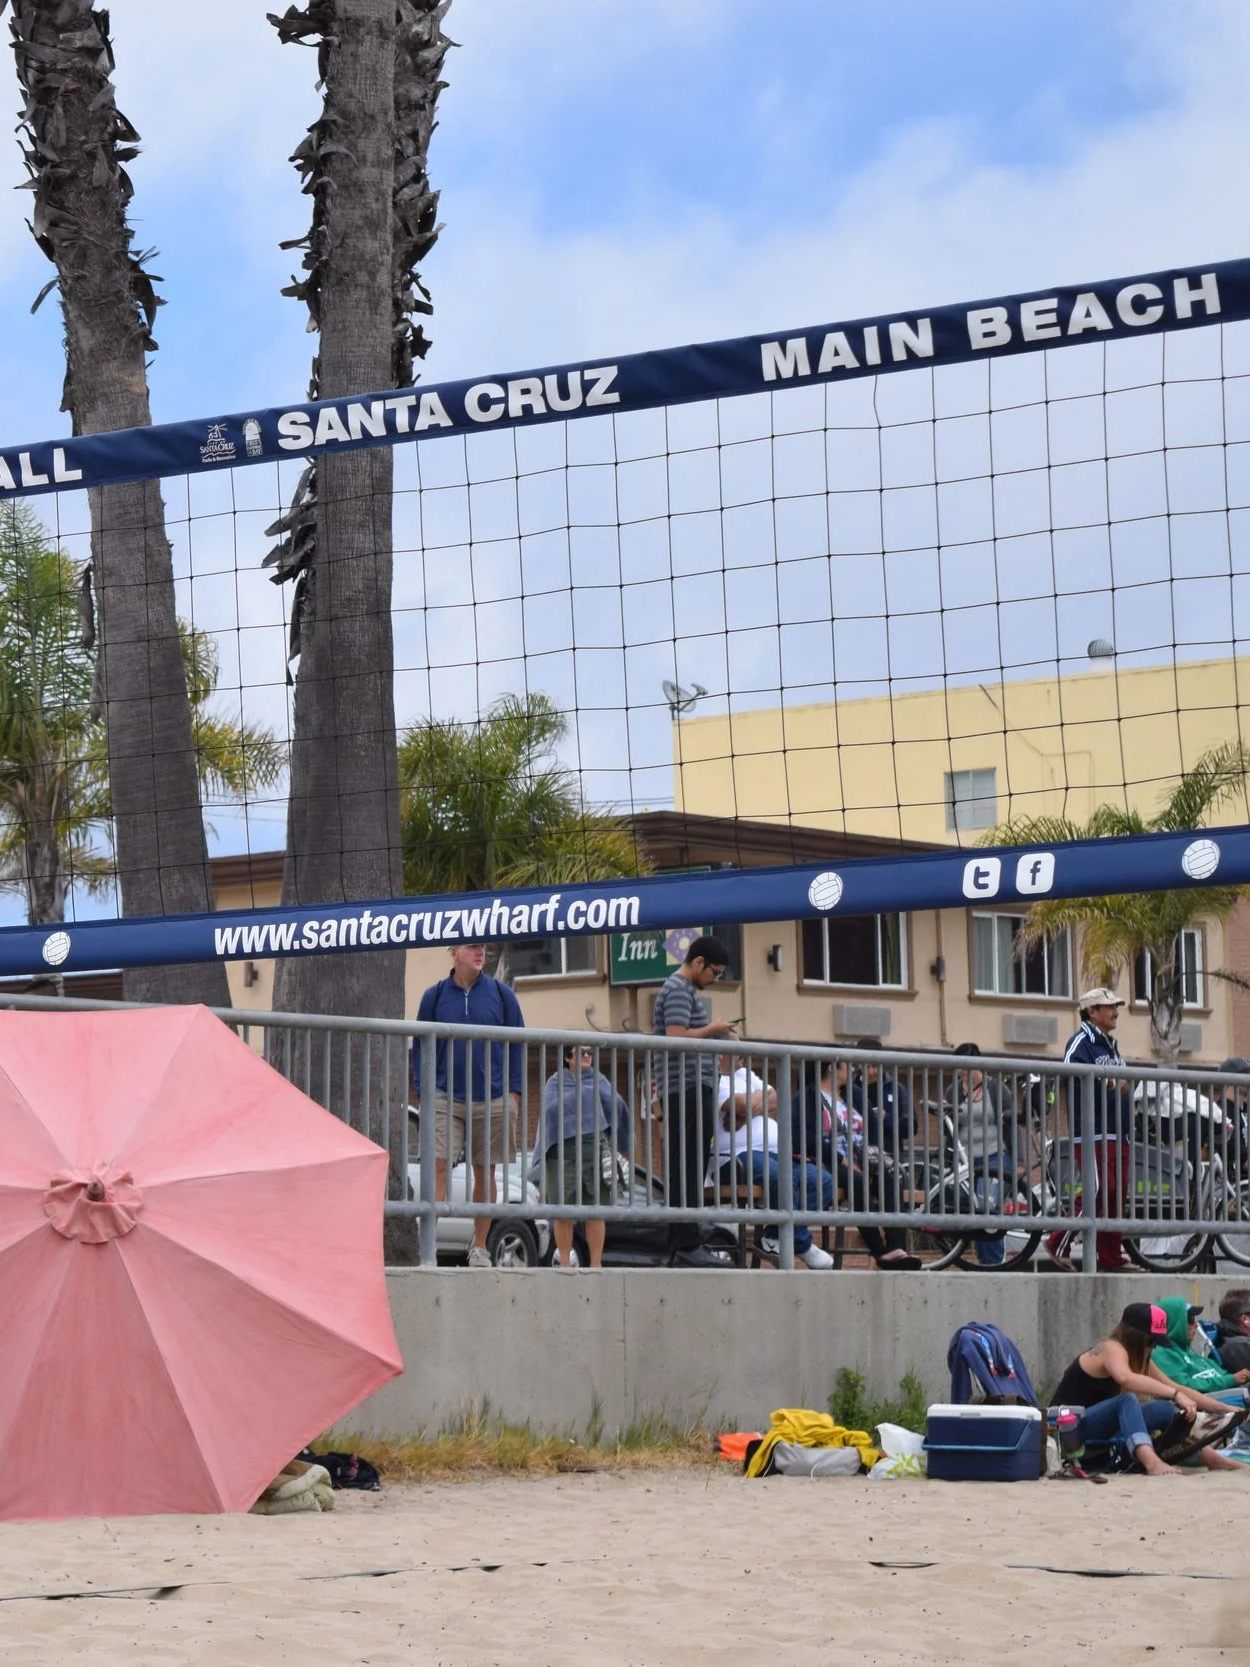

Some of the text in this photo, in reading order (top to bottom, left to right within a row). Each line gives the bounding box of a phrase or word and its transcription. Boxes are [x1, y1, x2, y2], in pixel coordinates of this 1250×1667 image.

[760, 272, 1222, 381] MAIN BEACH
[277, 391, 454, 450] SANTA
[464, 365, 620, 422] CRUZ
[214, 894, 640, 955] www.santacruzwharf.com
[617, 932, 658, 962] Inn
